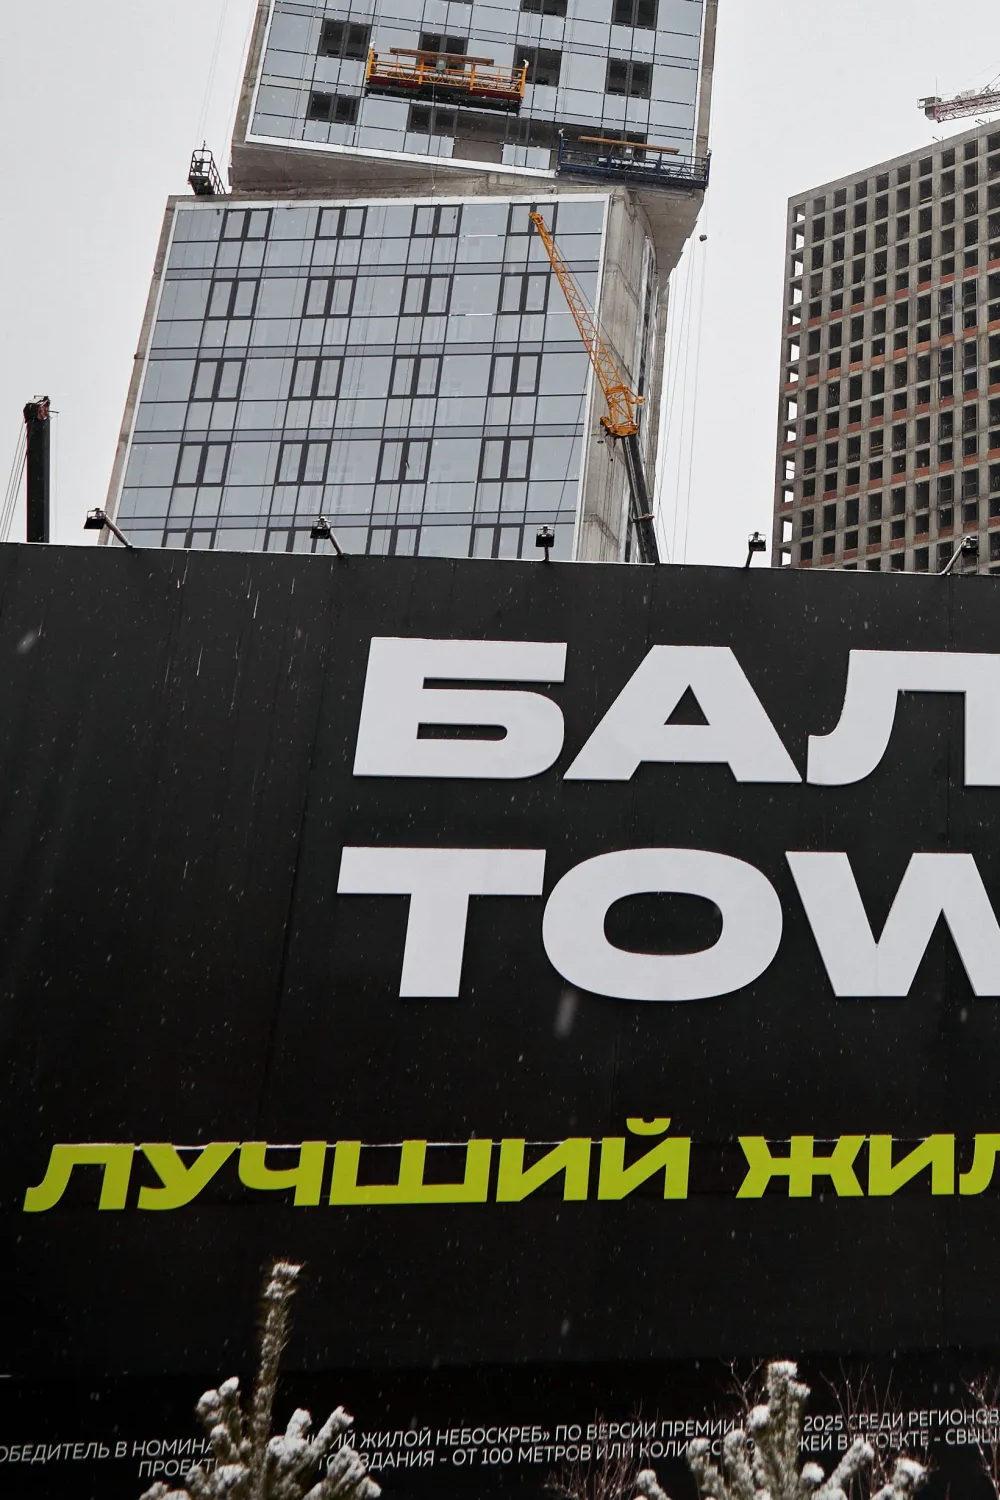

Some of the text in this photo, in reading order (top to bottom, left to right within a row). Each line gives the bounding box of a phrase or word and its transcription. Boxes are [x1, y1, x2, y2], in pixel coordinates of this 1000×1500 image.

[23, 1117, 690, 1212] ЛУЧШИЙ
[114, 1440, 128, 1459] В
[359, 1427, 431, 1449] ЖИЛОЙ
[435, 1424, 550, 1447] НЕБОСКРЕБ»
[554, 1423, 582, 1443] ПО
[586, 1419, 657, 1441] ВЕРСИИ
[660, 1418, 735, 1439] ПРЕМИИ
[803, 1413, 843, 1433] 2025
[848, 1410, 904, 1432] СРЕДИ
[908, 1407, 999, 1429] РЕГИОНОВ
[451, 1447, 478, 1466] ОТ
[481, 1447, 514, 1465] 100
[517, 1443, 592, 1464] МЕТРОВ
[596, 1440, 635, 1461] ИЛИ
[837, 1433, 848, 1451] В
